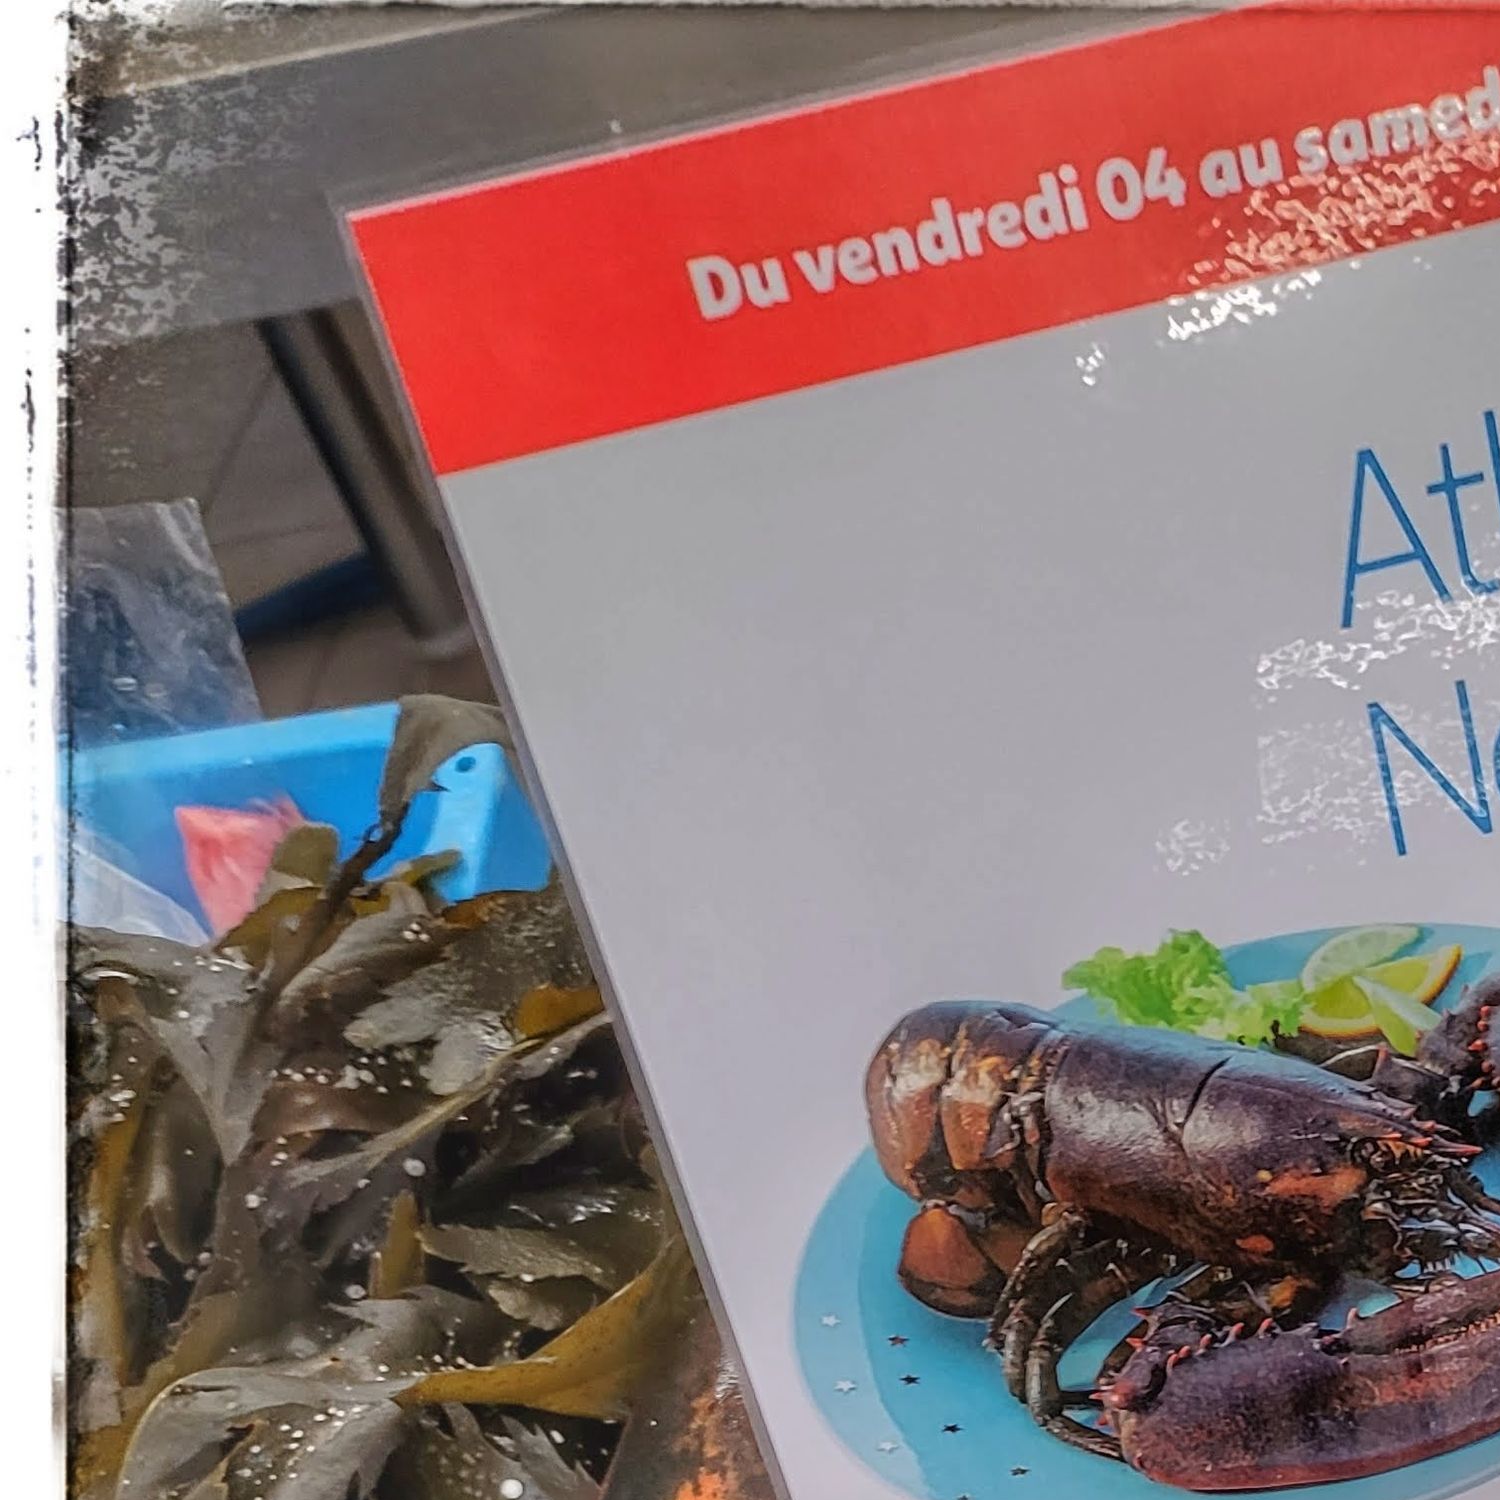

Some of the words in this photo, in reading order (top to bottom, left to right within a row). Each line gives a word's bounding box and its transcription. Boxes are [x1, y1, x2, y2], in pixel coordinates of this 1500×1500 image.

[687, 254, 790, 320] Du
[792, 163, 1087, 293] vendredi
[1098, 147, 1186, 221] 04
[1199, 137, 1283, 198] au
